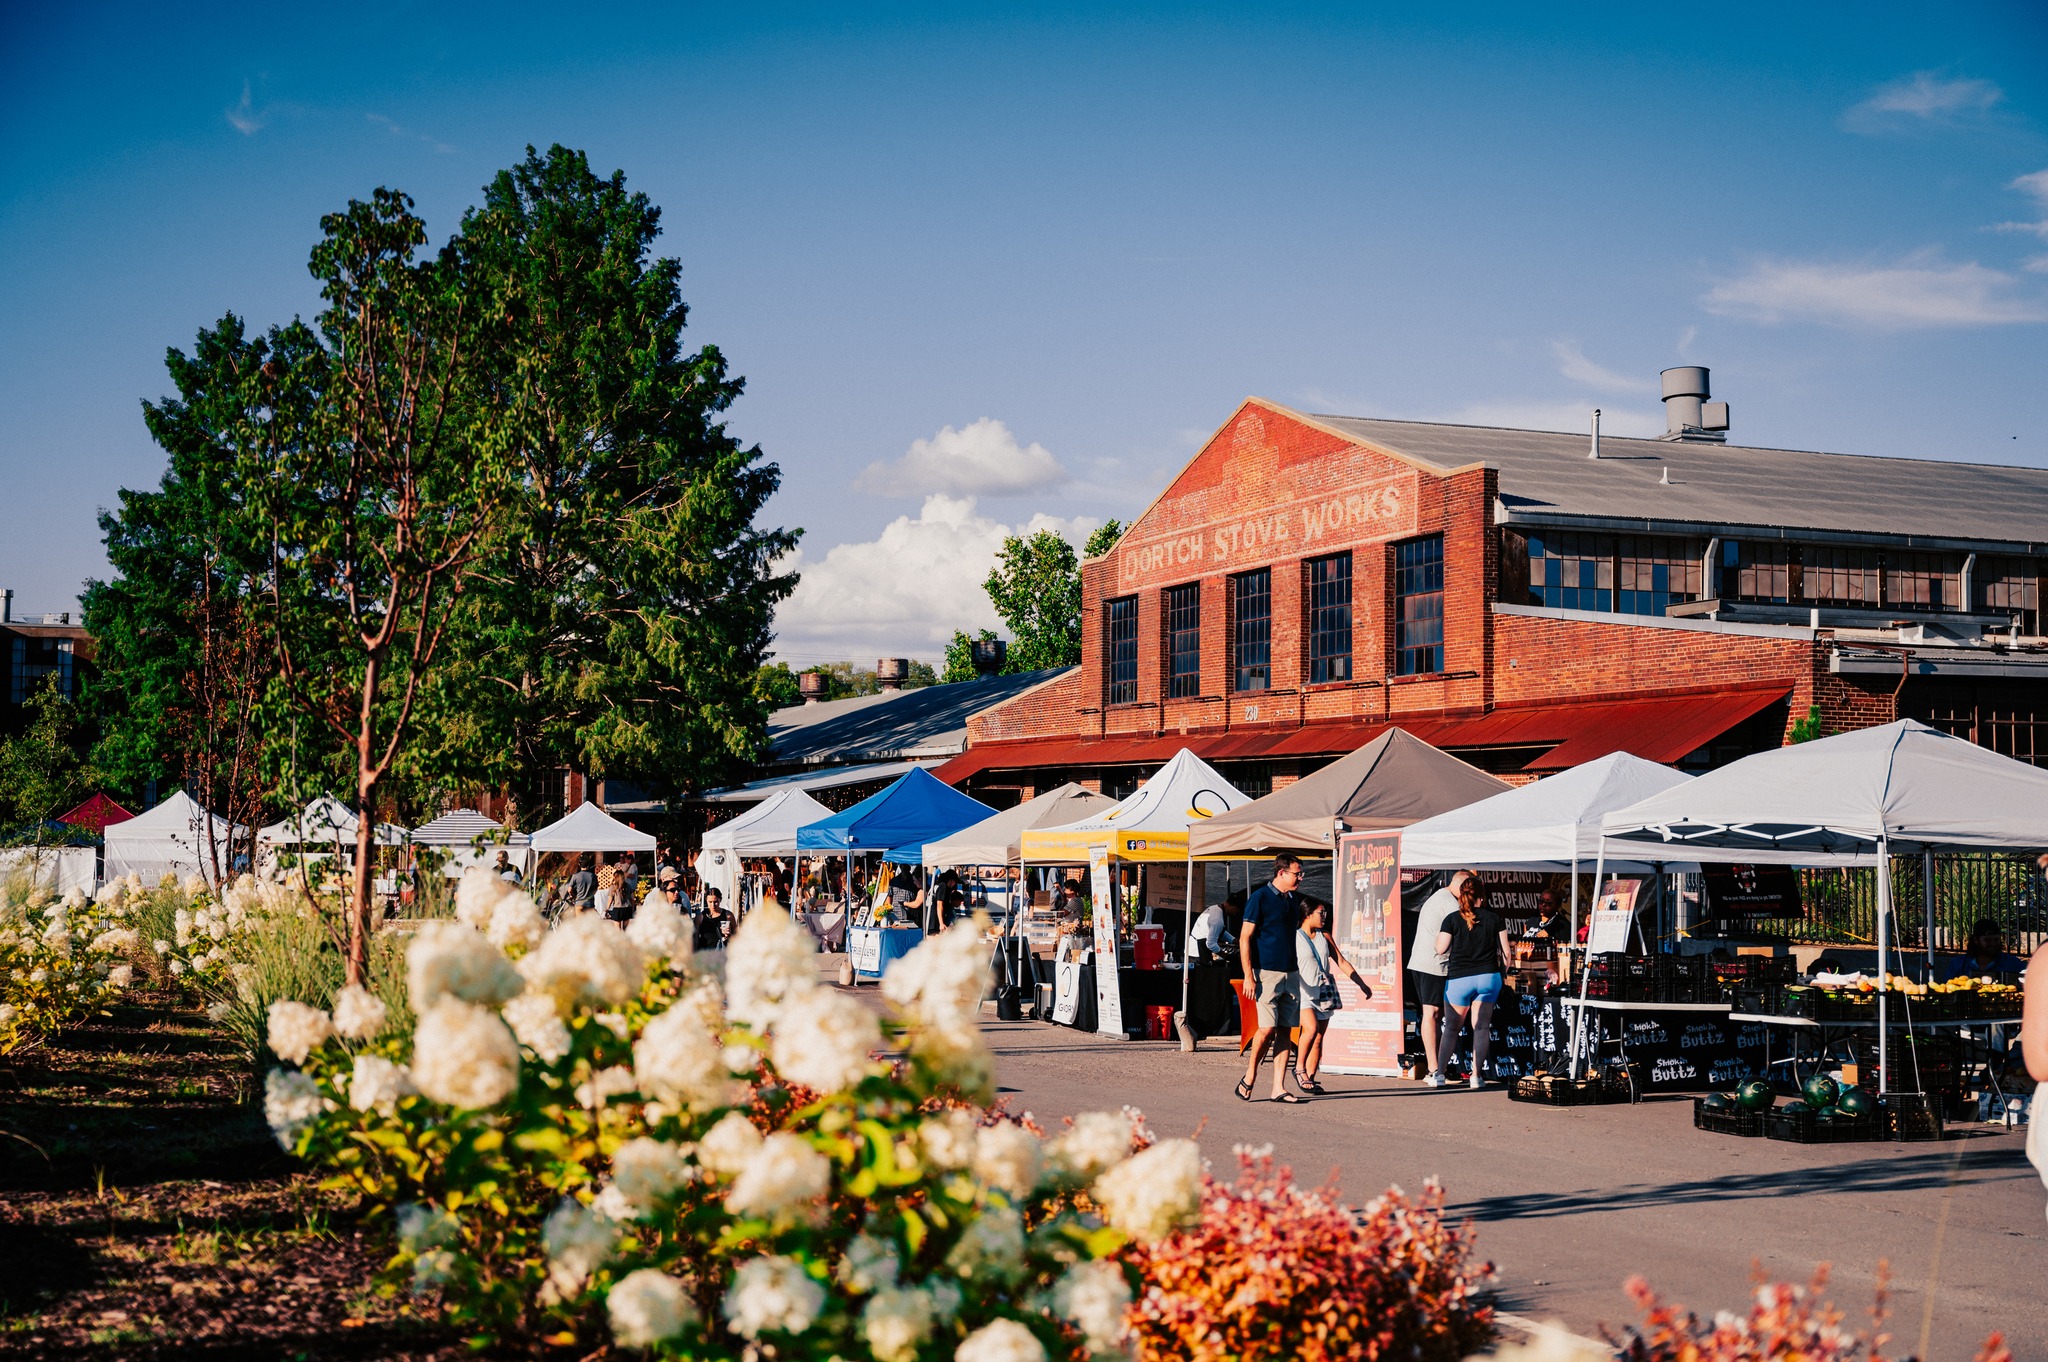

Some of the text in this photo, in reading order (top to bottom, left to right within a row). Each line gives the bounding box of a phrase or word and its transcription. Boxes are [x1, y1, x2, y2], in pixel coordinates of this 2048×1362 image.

[1124, 486, 1401, 581] DORTCH STOVE WORKS
[1245, 706, 1258, 721] 230
[1350, 843, 1393, 864] Put Some
[1346, 862, 1365, 873] Sauce
[1366, 862, 1380, 870] and
[1370, 868, 1390, 886] on it
[1477, 871, 1543, 884] RIED PEANUTS
[1505, 892, 1542, 909] PEANUT
[1504, 918, 1529, 935] BUTT
[1686, 1023, 1716, 1034] Smokin
[1680, 1031, 1725, 1048] Buttz
[1656, 1056, 1688, 1068] Smokin
[1714, 1057, 1744, 1068] Smokin
[1652, 1064, 1696, 1082] Buttz
[1708, 1065, 1752, 1083] Buttz
